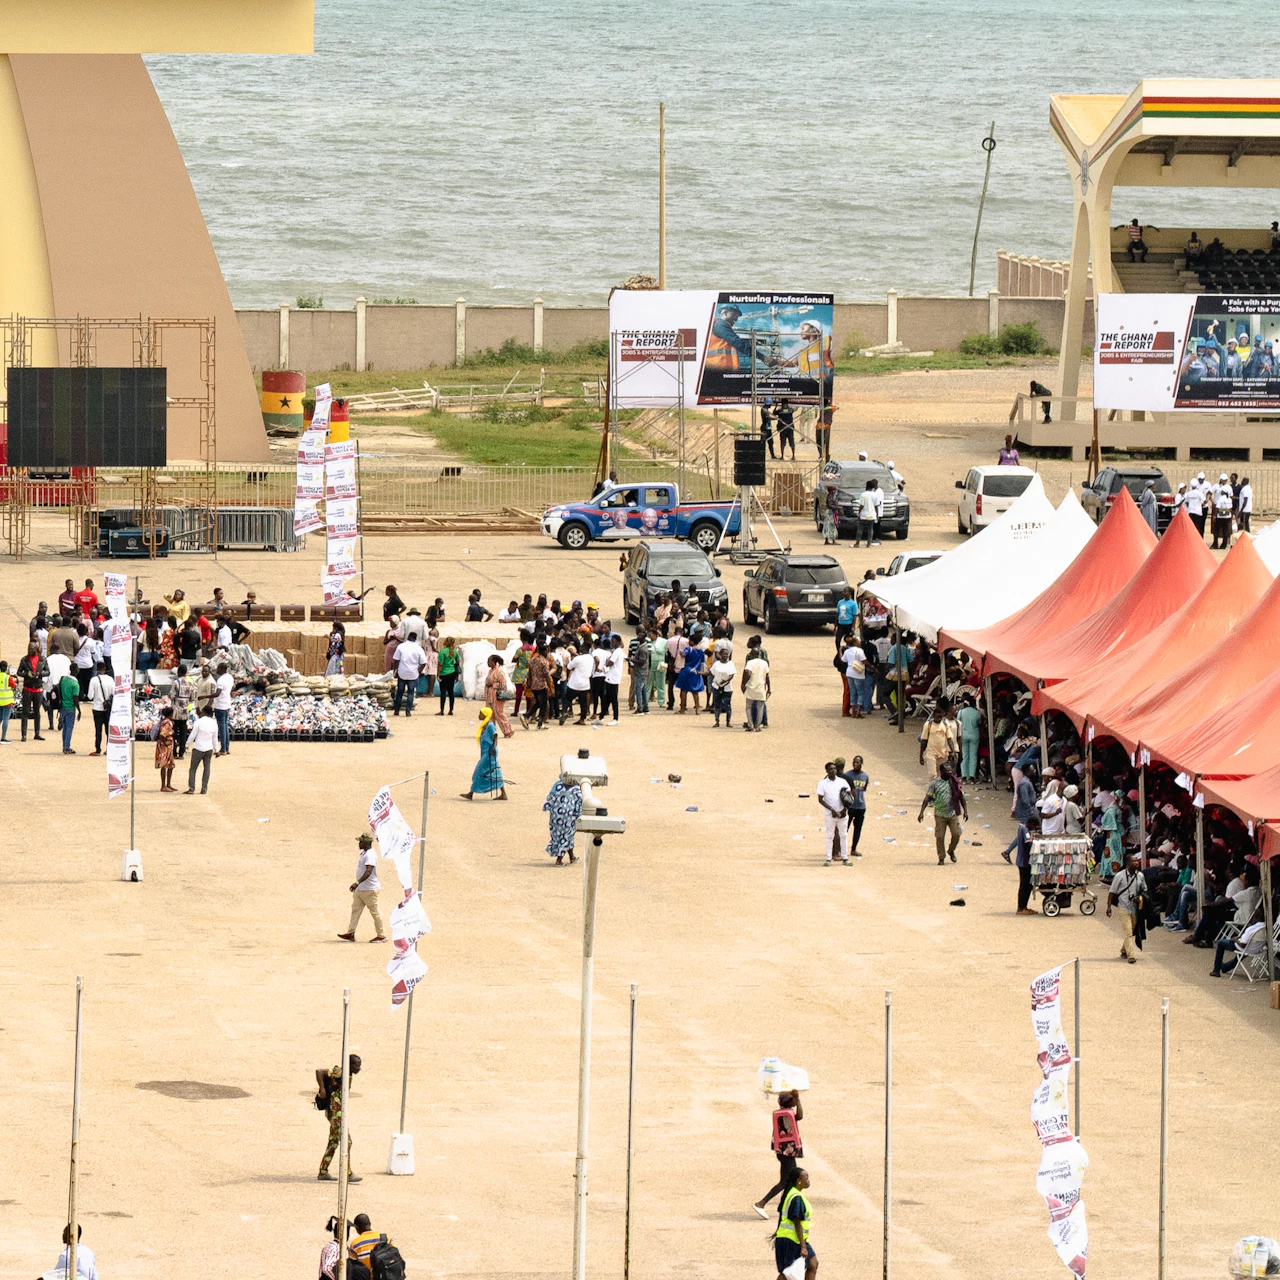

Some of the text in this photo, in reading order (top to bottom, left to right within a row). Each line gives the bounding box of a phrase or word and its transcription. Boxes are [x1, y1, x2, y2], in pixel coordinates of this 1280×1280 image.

[729, 295, 830, 304] Nurturing Professionals
[1101, 333, 1154, 341] THE GHANA
